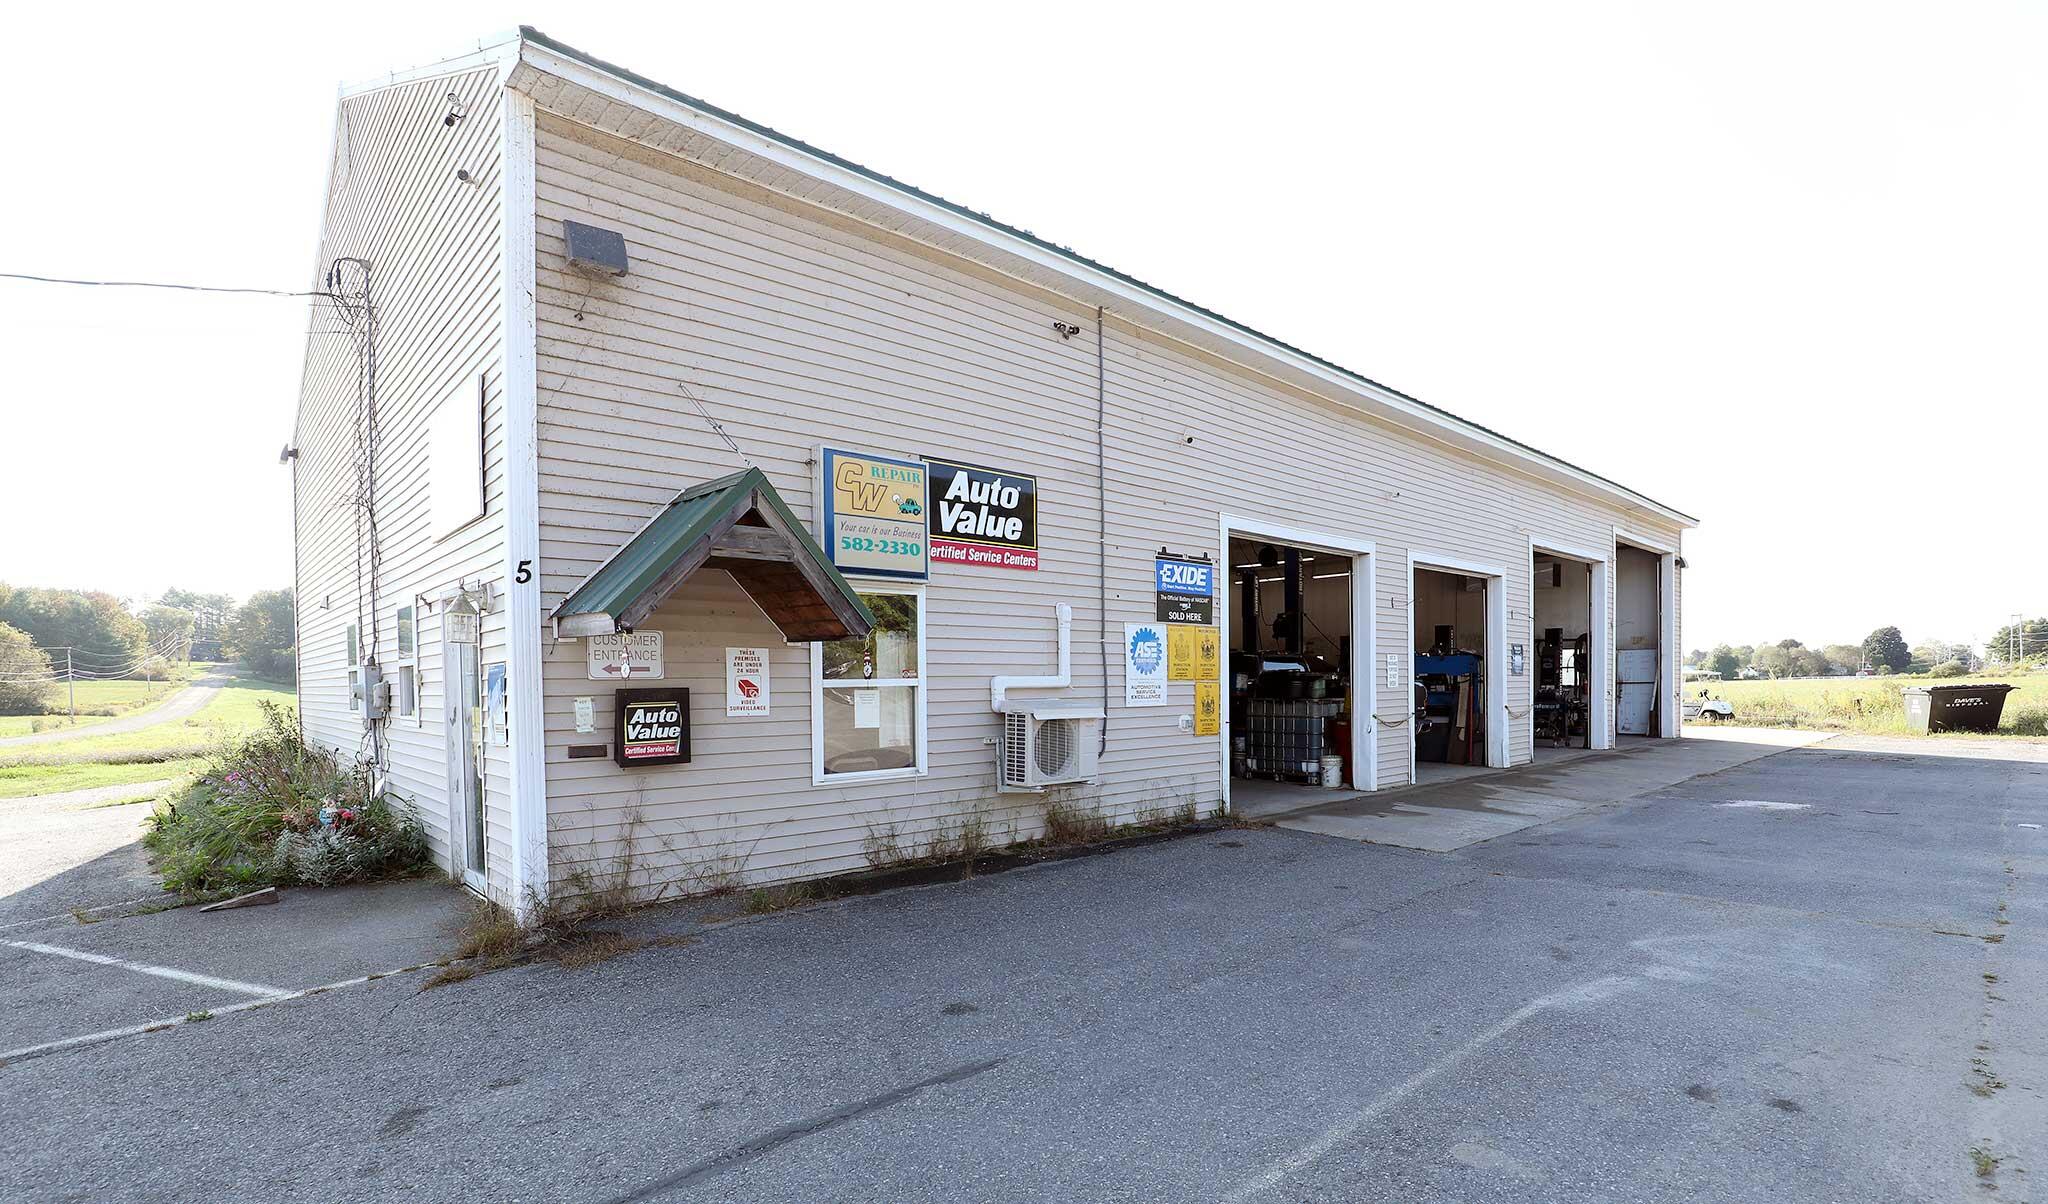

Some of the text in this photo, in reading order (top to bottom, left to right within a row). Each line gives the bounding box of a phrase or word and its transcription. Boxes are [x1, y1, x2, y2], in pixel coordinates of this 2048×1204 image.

[871, 466, 920, 483] REPAIR
[836, 462, 888, 512] CW
[944, 470, 1019, 509] Auto
[840, 520, 921, 540] Your car is our Business
[939, 501, 1023, 540] Value
[841, 535, 921, 557] 582-2330
[930, 545, 1036, 567] ertified Service Centers
[515, 559, 532, 584] 5
[1160, 563, 1208, 586] EXIDE
[1168, 611, 1202, 622] SOLD HERE
[593, 634, 658, 646] CUSTOMER
[1134, 641, 1158, 658] ASE
[629, 707, 678, 724] Auto
[627, 723, 681, 740] Value
[624, 746, 646, 755] Certified
[646, 745, 665, 754] Service
